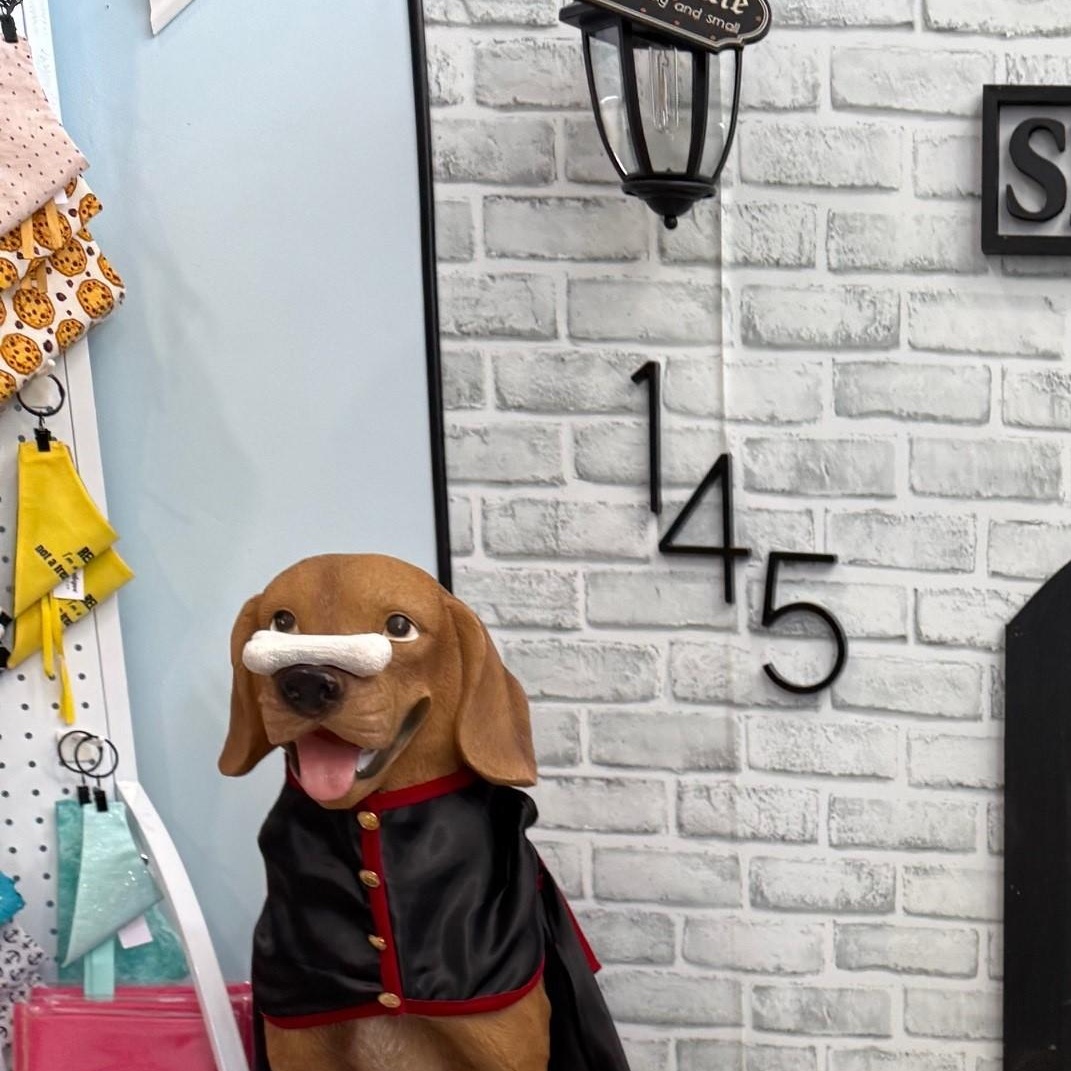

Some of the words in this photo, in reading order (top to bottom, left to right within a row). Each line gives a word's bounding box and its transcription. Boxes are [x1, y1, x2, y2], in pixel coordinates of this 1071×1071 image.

[674, 2, 702, 19] and
[706, 14, 740, 33] small
[631, 360, 847, 694] 145
